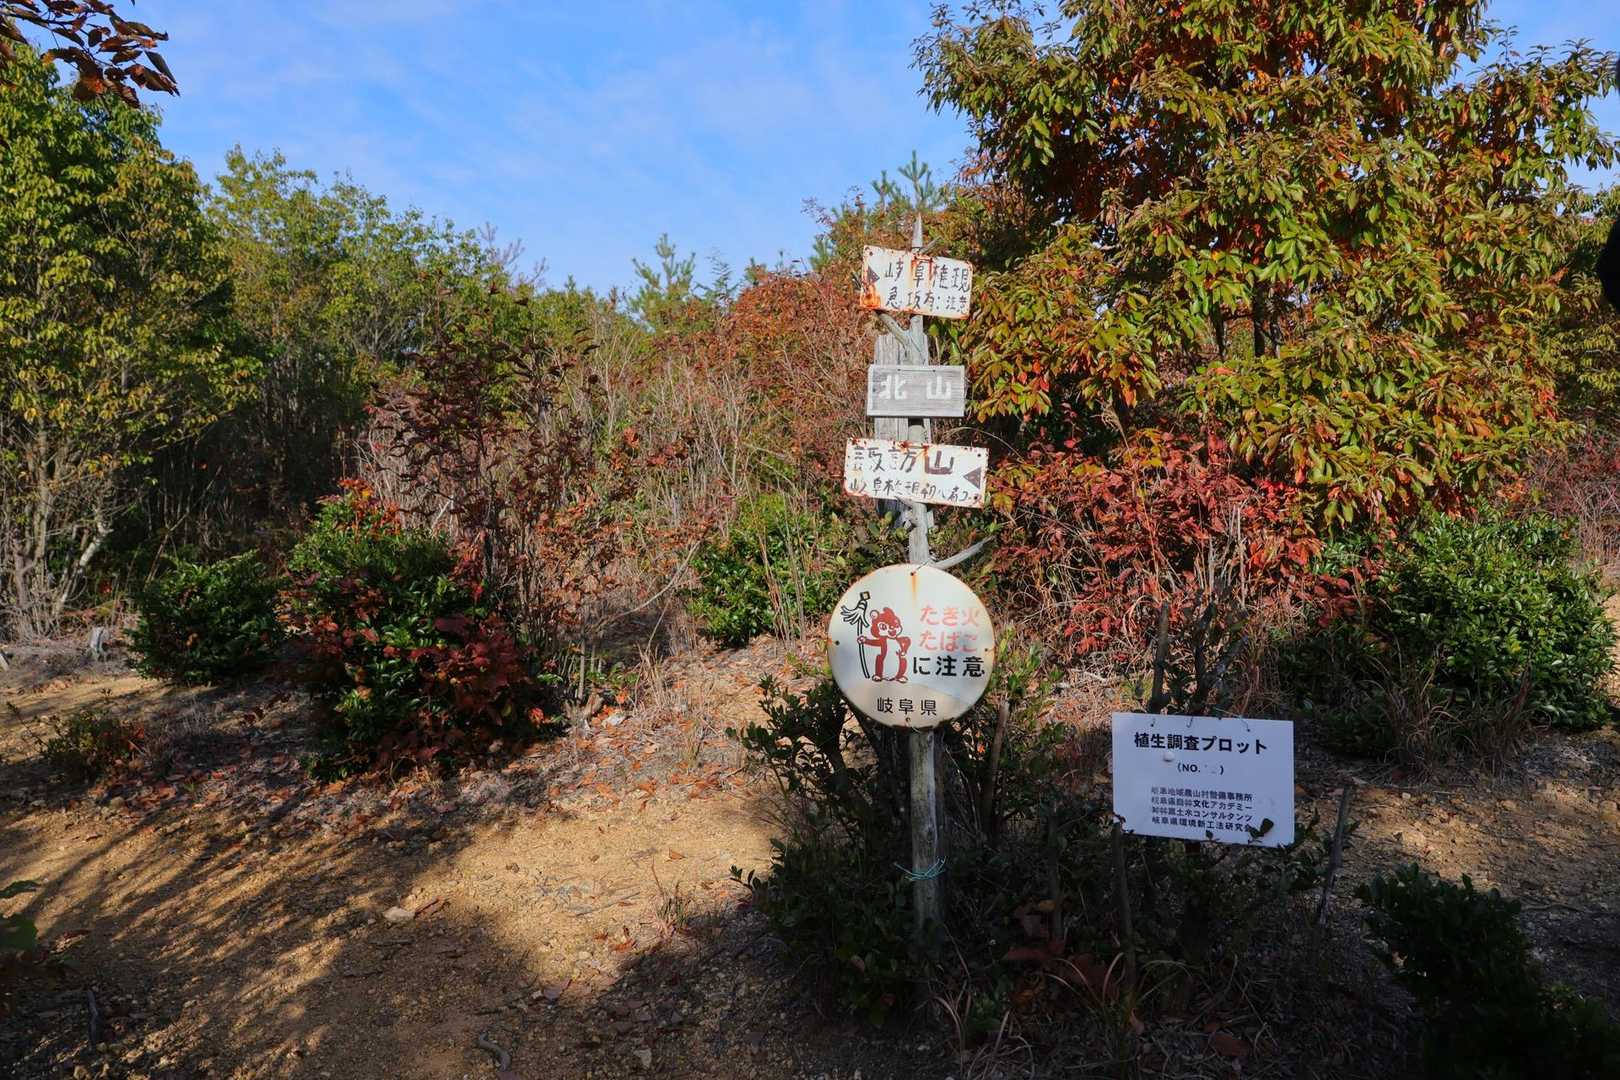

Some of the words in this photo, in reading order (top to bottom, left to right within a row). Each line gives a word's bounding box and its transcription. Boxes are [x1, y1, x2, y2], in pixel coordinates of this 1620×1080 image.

[879, 374, 952, 400] 北山
[920, 602, 979, 627] たき火
[919, 629, 978, 653] たばこ
[913, 655, 985, 678] に注意
[876, 697, 937, 716] 岐阜県
[1134, 731, 1267, 755] 植生調査プロット
